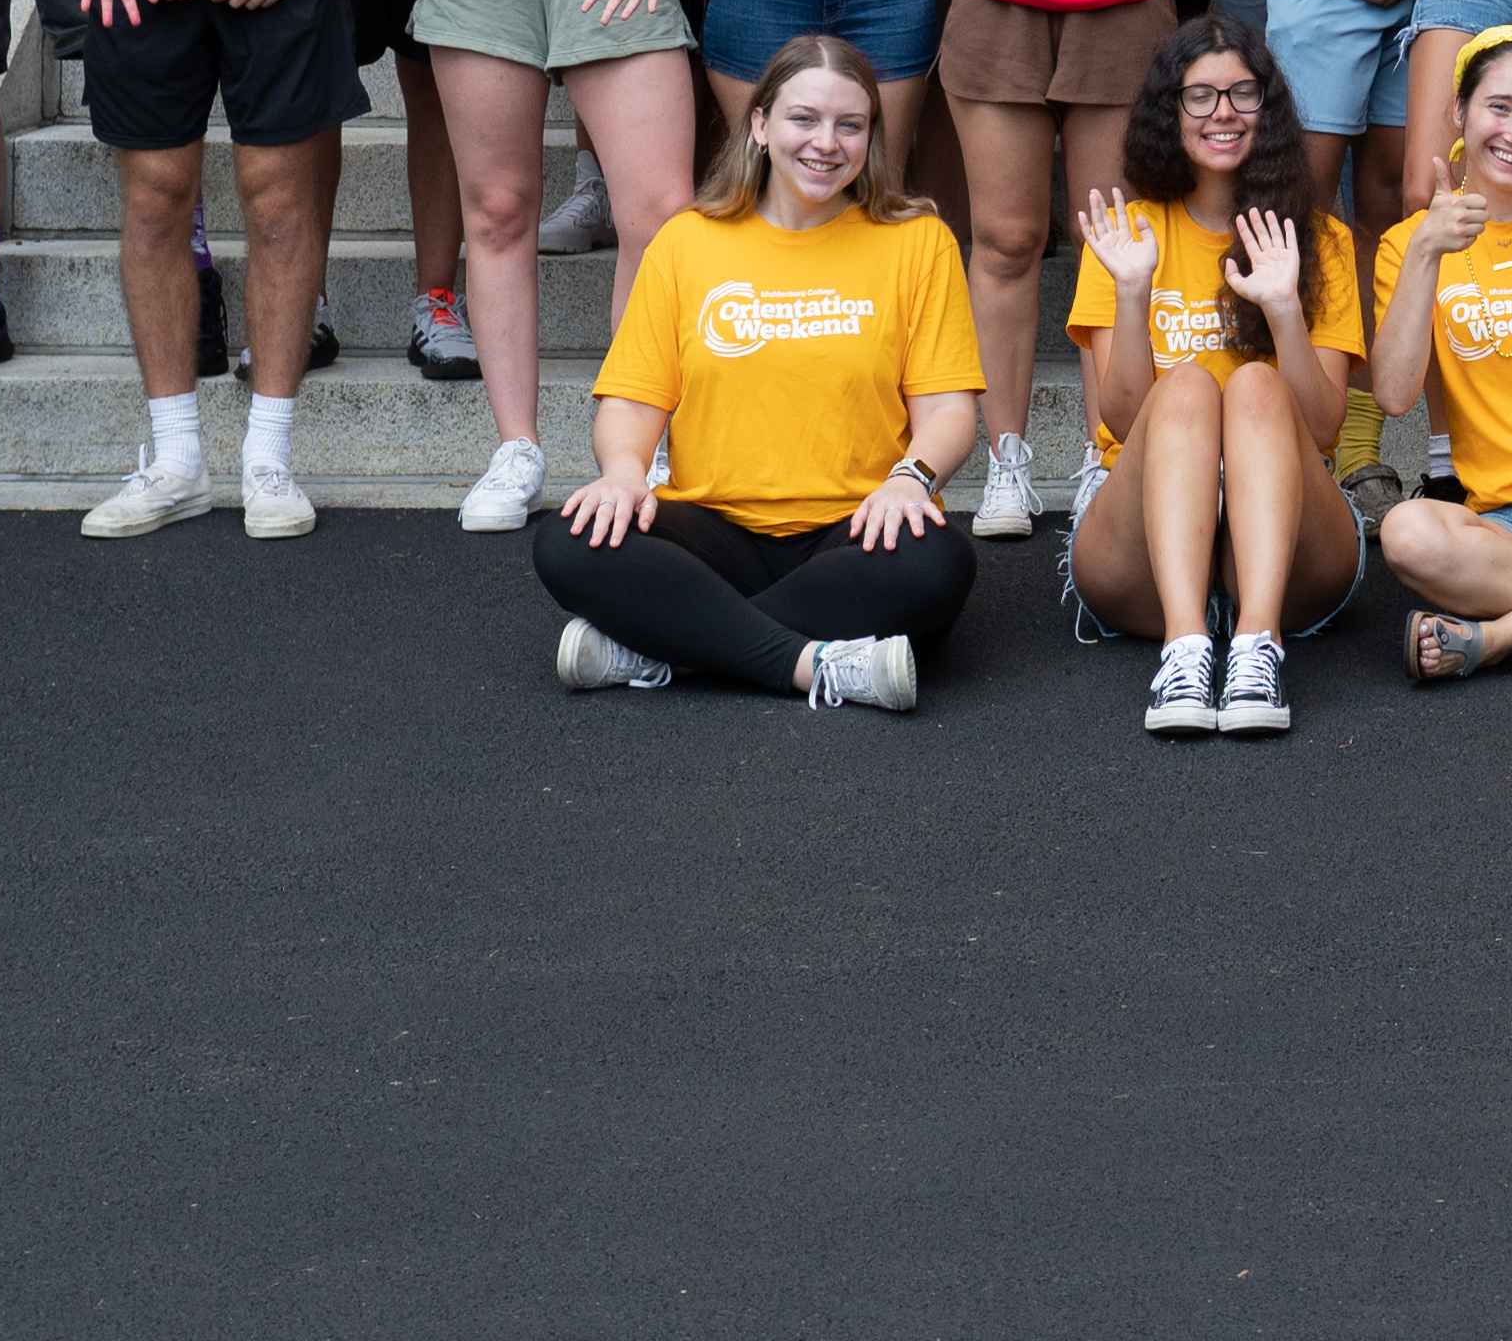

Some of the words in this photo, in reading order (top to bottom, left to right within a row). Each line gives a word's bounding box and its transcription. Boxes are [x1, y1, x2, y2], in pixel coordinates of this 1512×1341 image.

[718, 294, 875, 321] Orientation
[759, 290, 807, 301] Muhlenberg
[806, 288, 837, 299] College
[734, 314, 862, 342] Weekend
